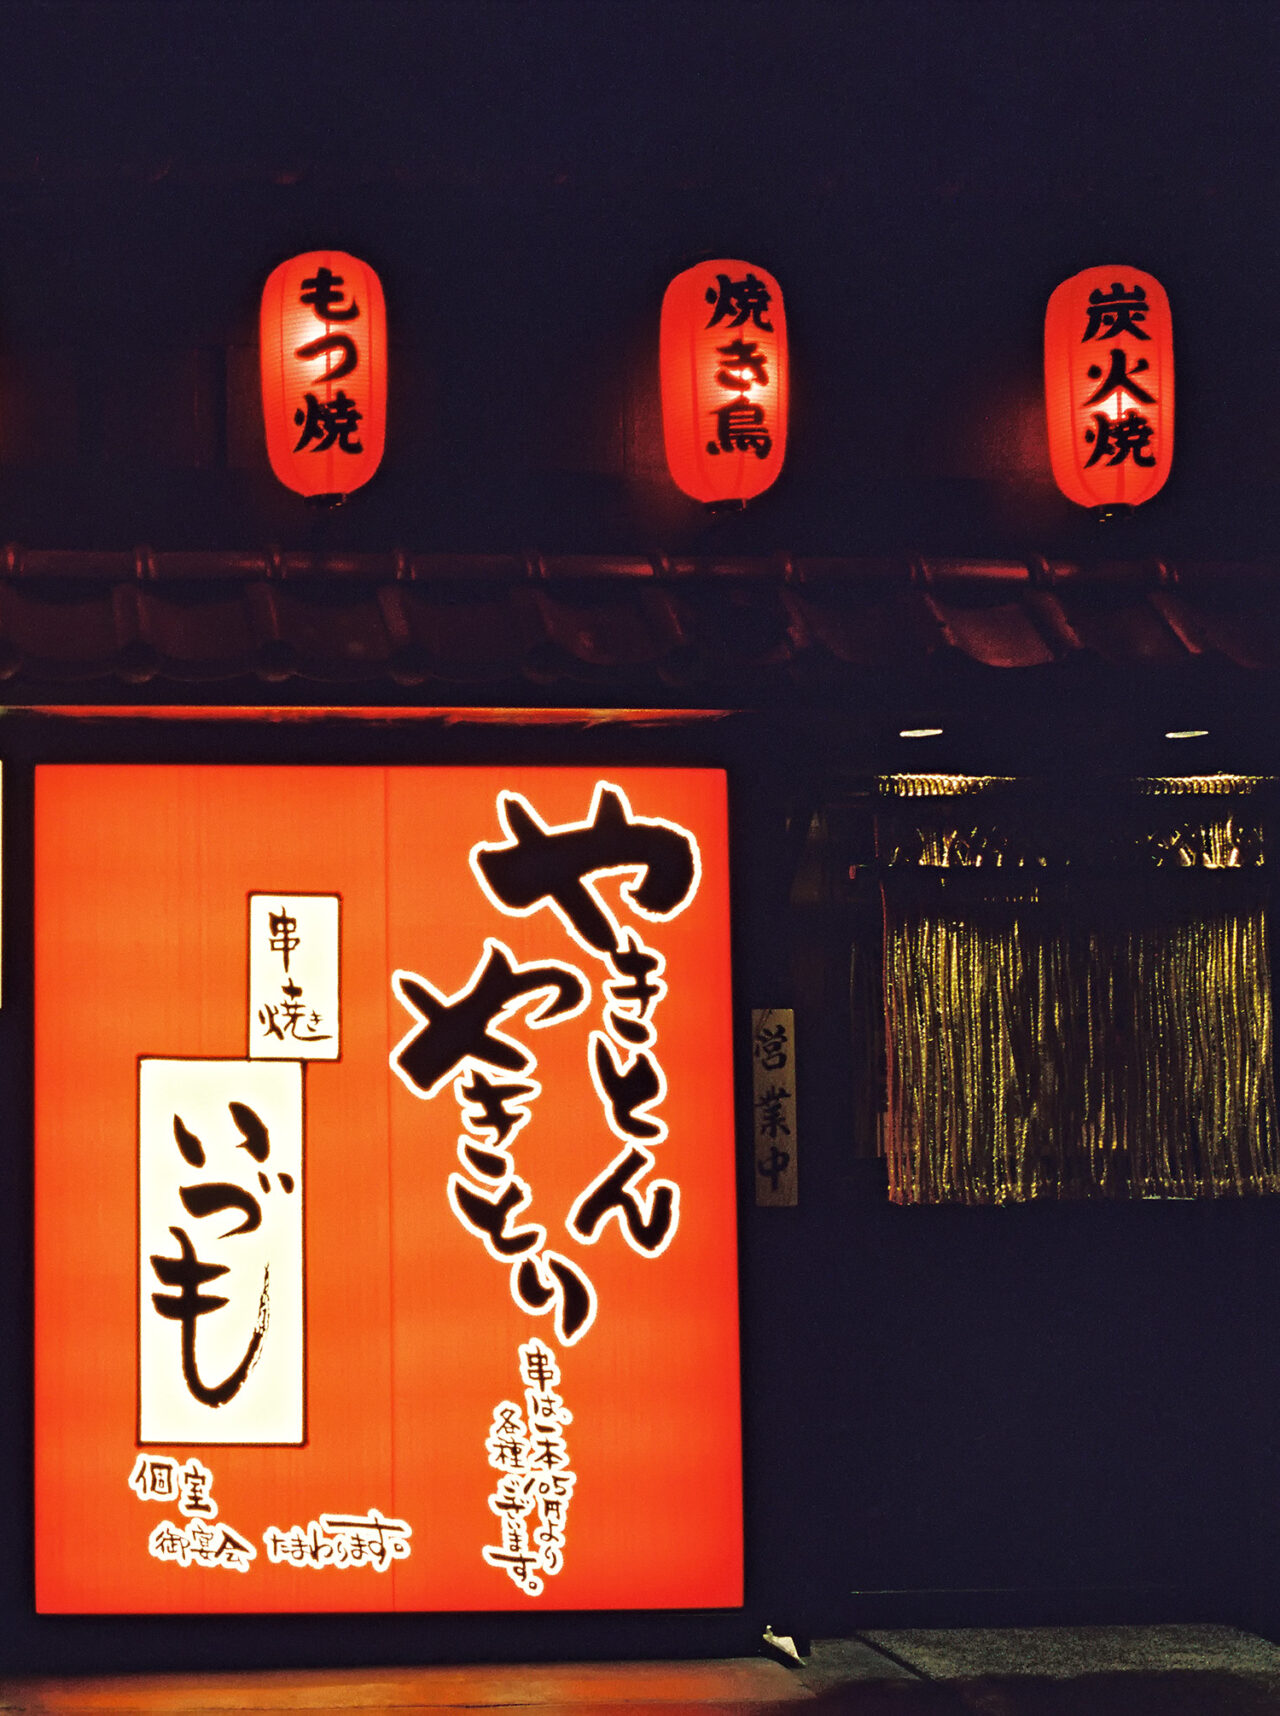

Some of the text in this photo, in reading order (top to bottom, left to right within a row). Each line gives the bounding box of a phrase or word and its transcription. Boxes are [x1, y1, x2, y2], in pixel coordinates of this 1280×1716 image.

[292, 266, 364, 455] もつ焼
[704, 273, 774, 459] 焼き鳥
[1081, 282, 1157, 469] 炭火焼
[258, 905, 333, 1042] 串焼き
[471, 784, 699, 1255] やきとん
[392, 939, 593, 1342] やきとり
[754, 1024, 792, 1192] 営業中
[151, 1101, 295, 1409] いづも
[134, 1459, 212, 1512] 個室
[154, 1524, 251, 1566] 御宴会
